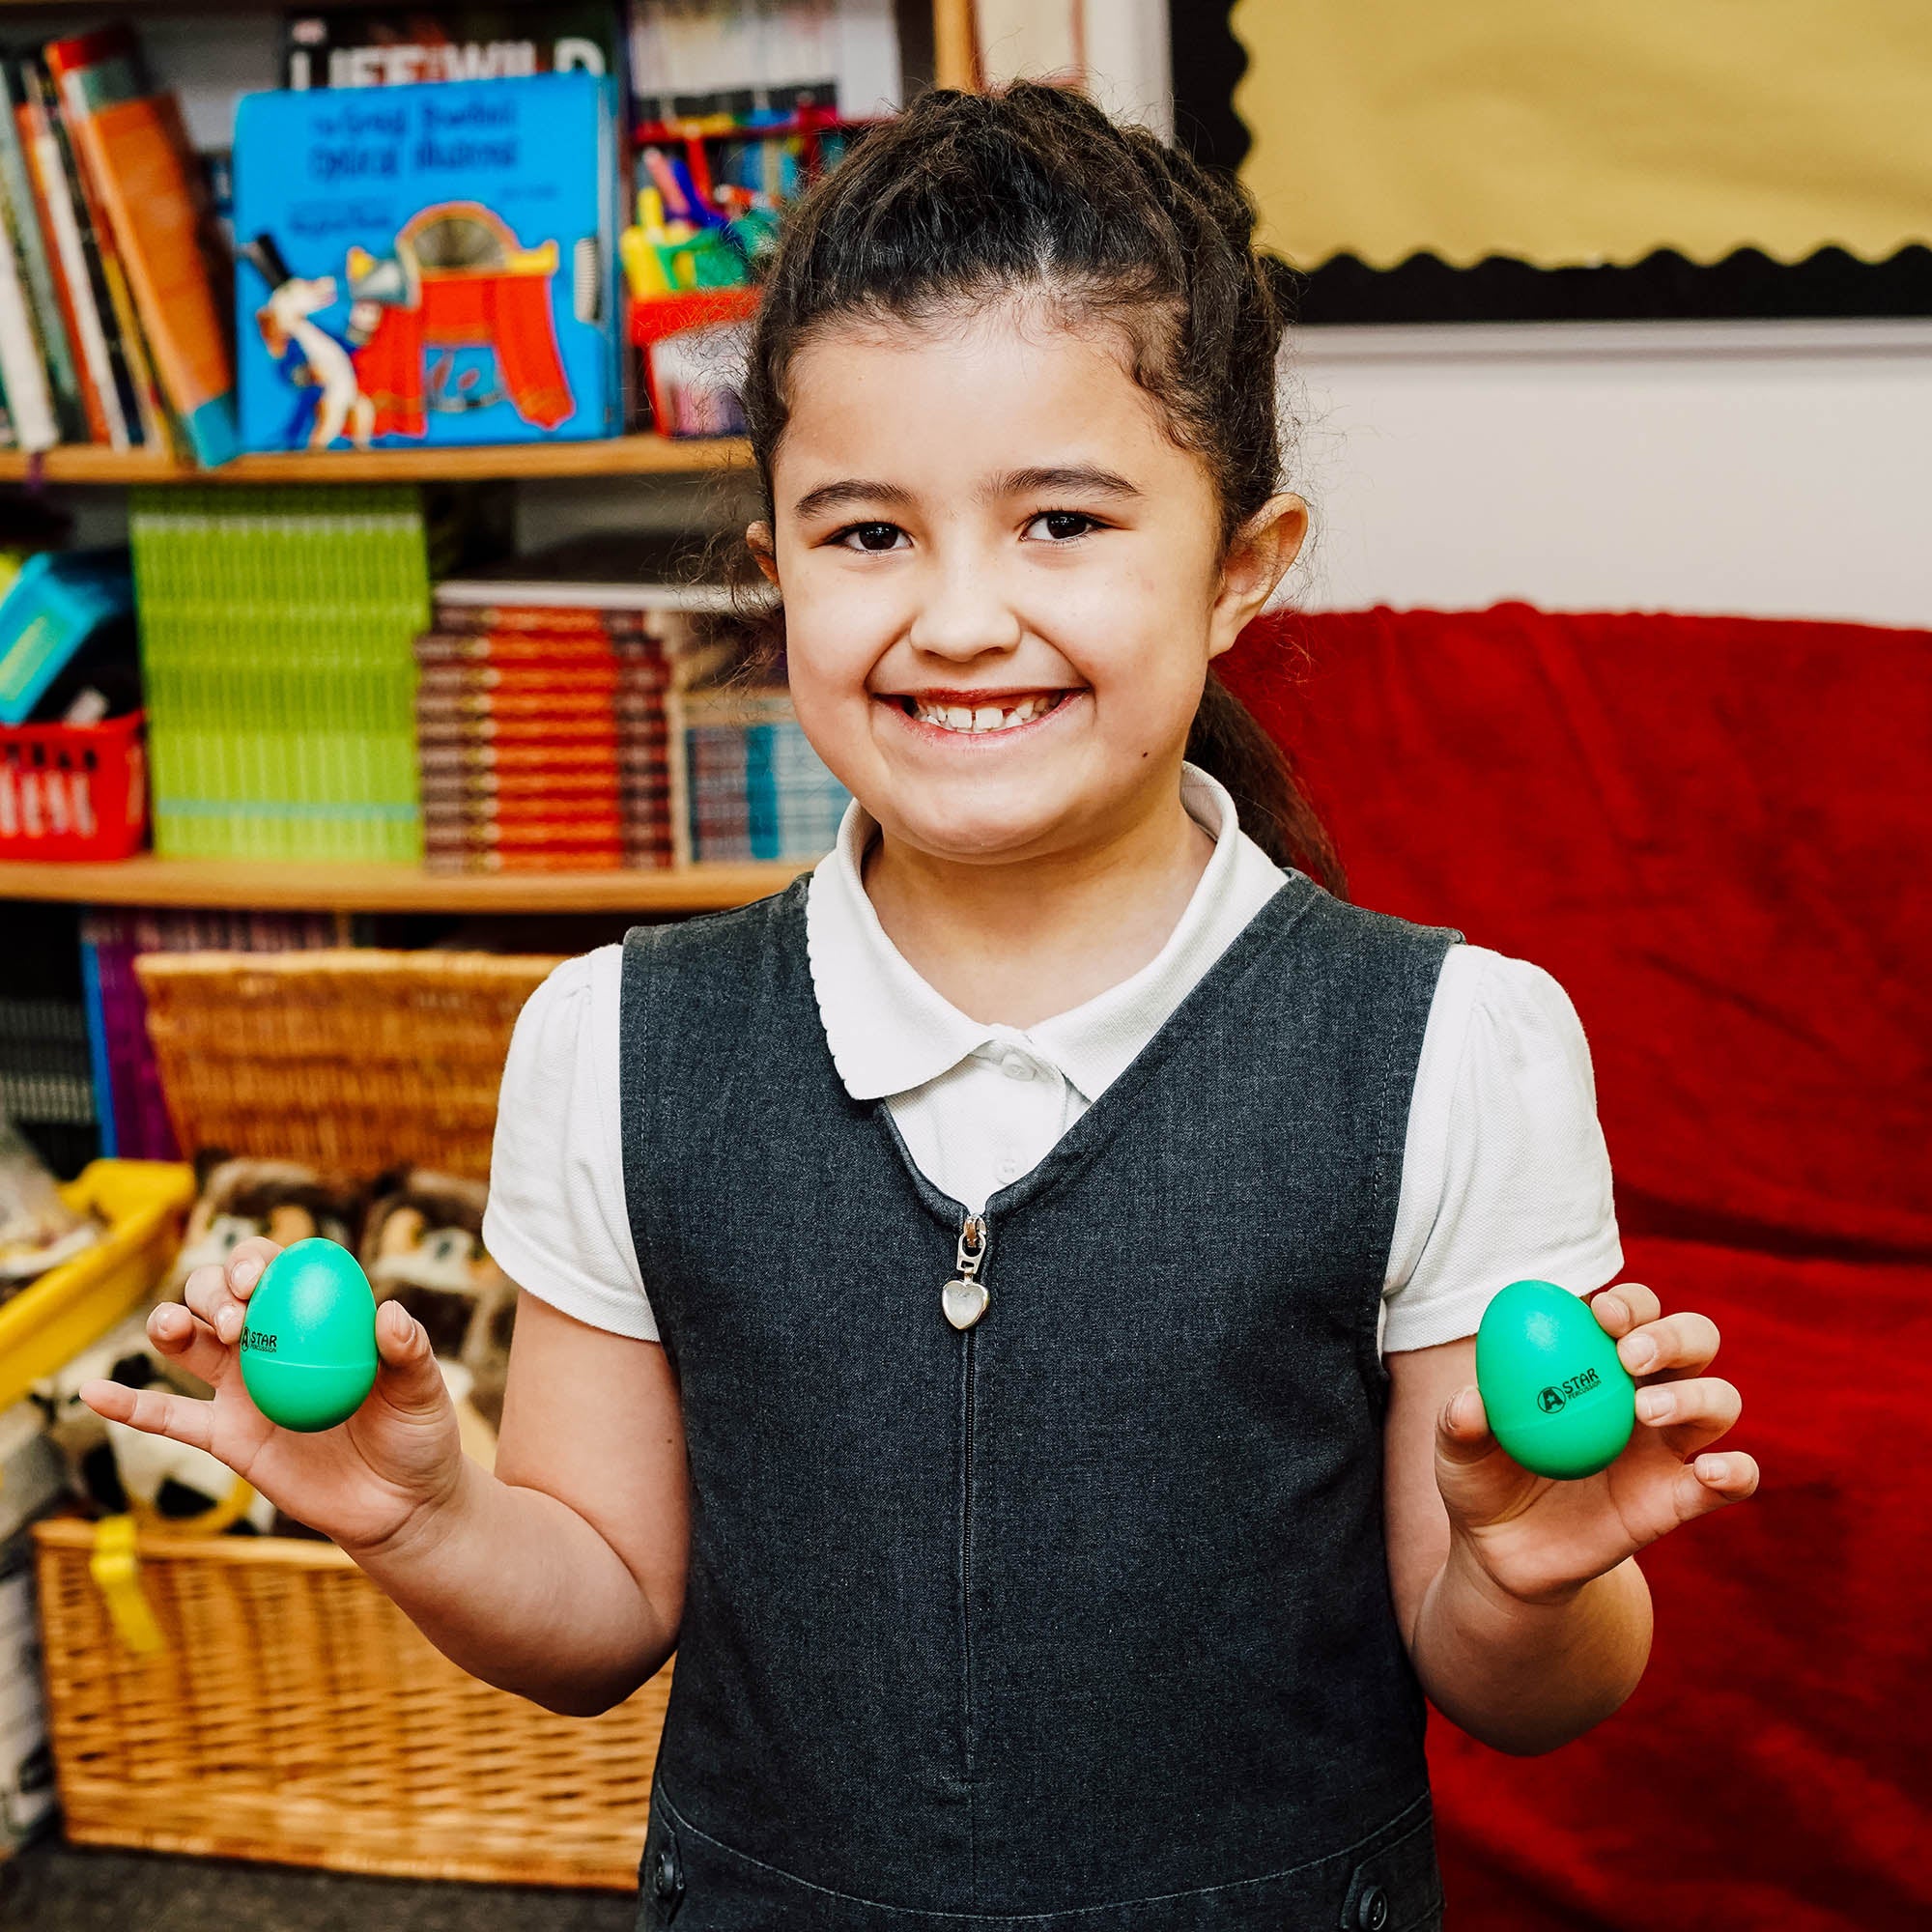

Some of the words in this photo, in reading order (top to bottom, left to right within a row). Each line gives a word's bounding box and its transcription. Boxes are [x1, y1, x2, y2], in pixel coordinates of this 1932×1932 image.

[251, 1331, 277, 1348] STAR
[1542, 1387, 1565, 1411] A
[1562, 1368, 1599, 1394] STAR
